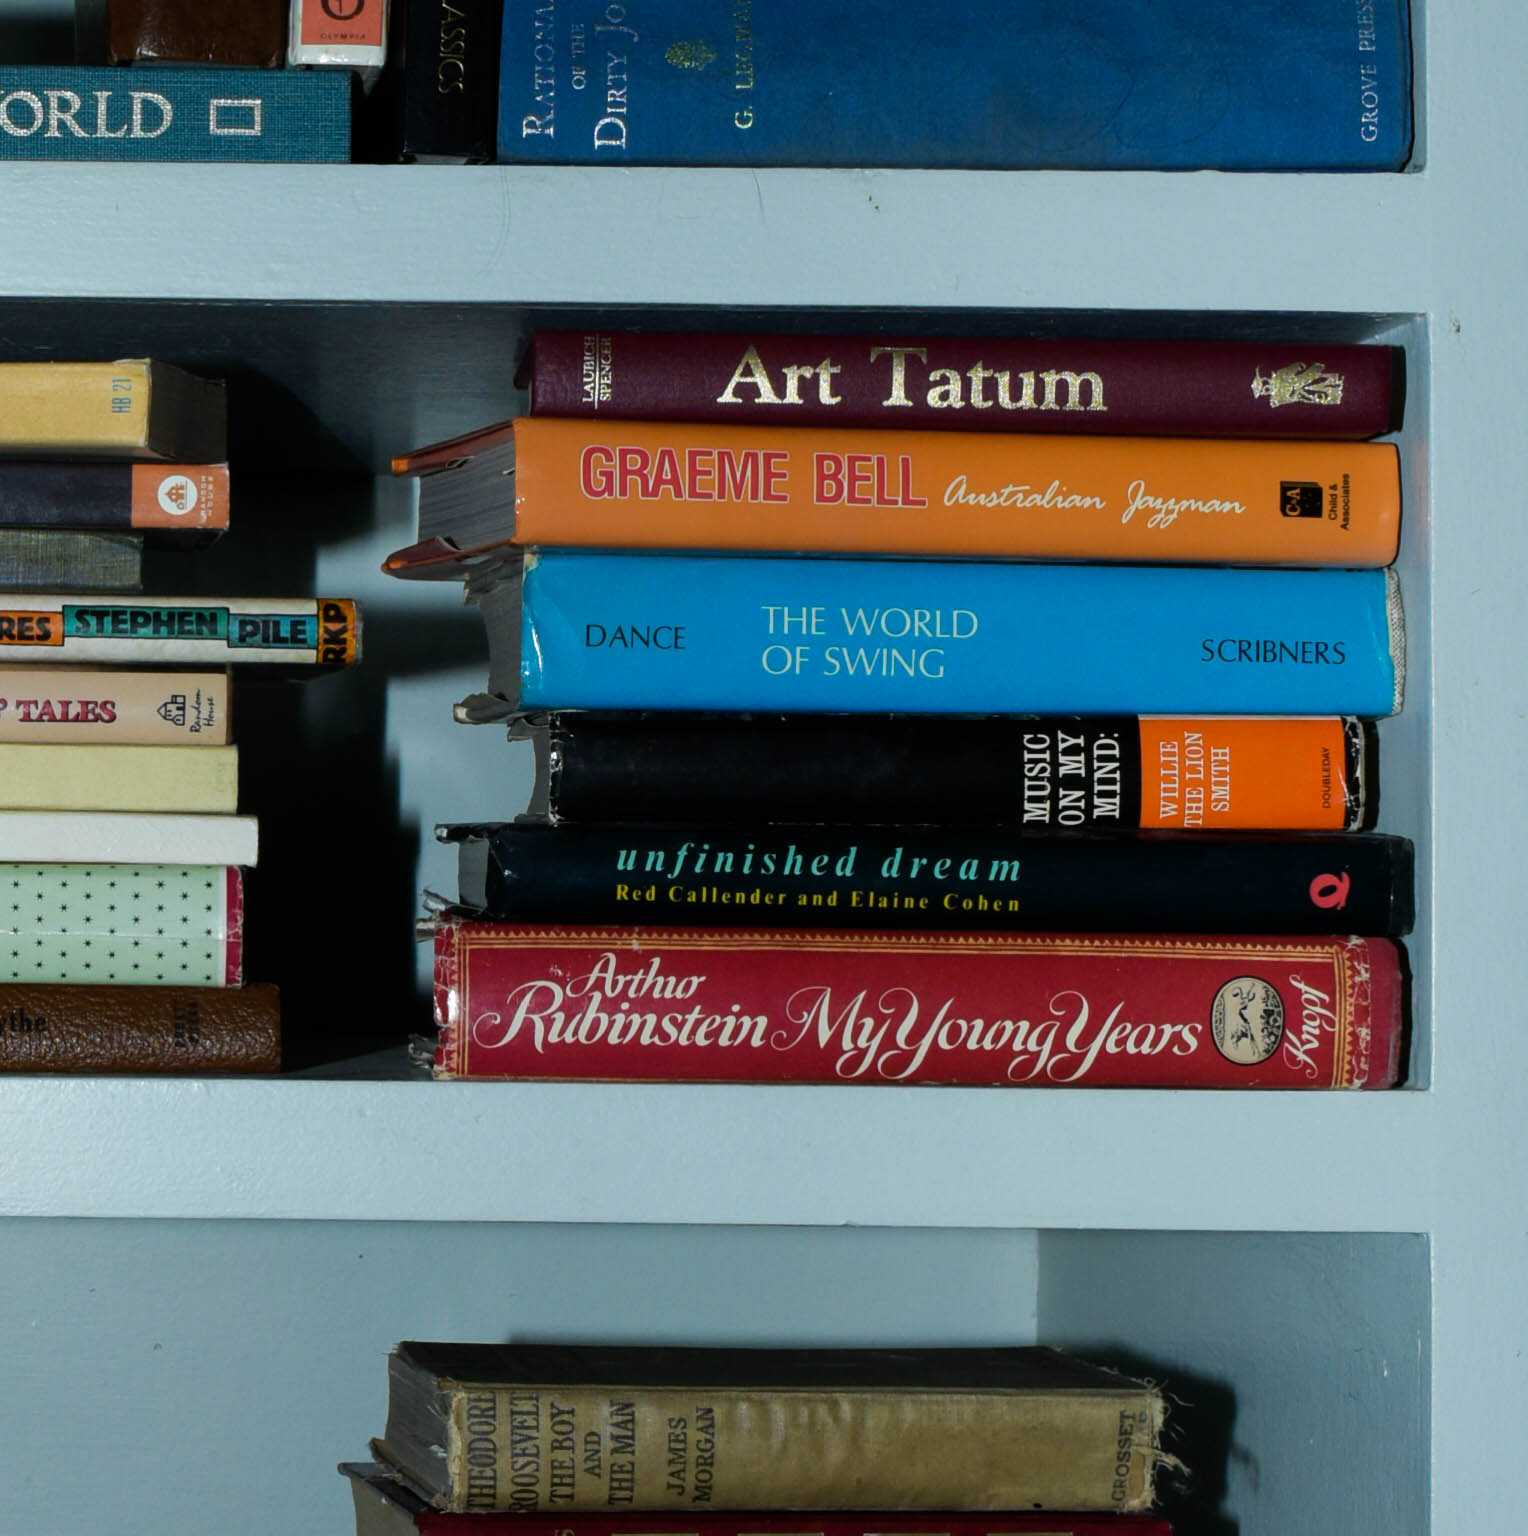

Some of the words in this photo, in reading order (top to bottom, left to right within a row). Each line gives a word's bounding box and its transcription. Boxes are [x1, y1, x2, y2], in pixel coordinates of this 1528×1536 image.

[717, 344, 842, 405] Art
[870, 346, 1108, 411] Tatum
[580, 445, 789, 504] GRAEME
[814, 451, 927, 508] BELL
[75, 607, 217, 637] STEPHEN
[237, 617, 308, 645] PILE
[586, 624, 686, 649] DANCE
[1202, 638, 1346, 665] SCRIBNERS
[616, 841, 857, 879] unfinished
[882, 847, 1021, 881] dream
[565, 952, 706, 1000] Arthur
[473, 979, 768, 1054] Rubinstein
[668, 1416, 686, 1496] JAMES
[693, 1406, 715, 1503] MORGAN
